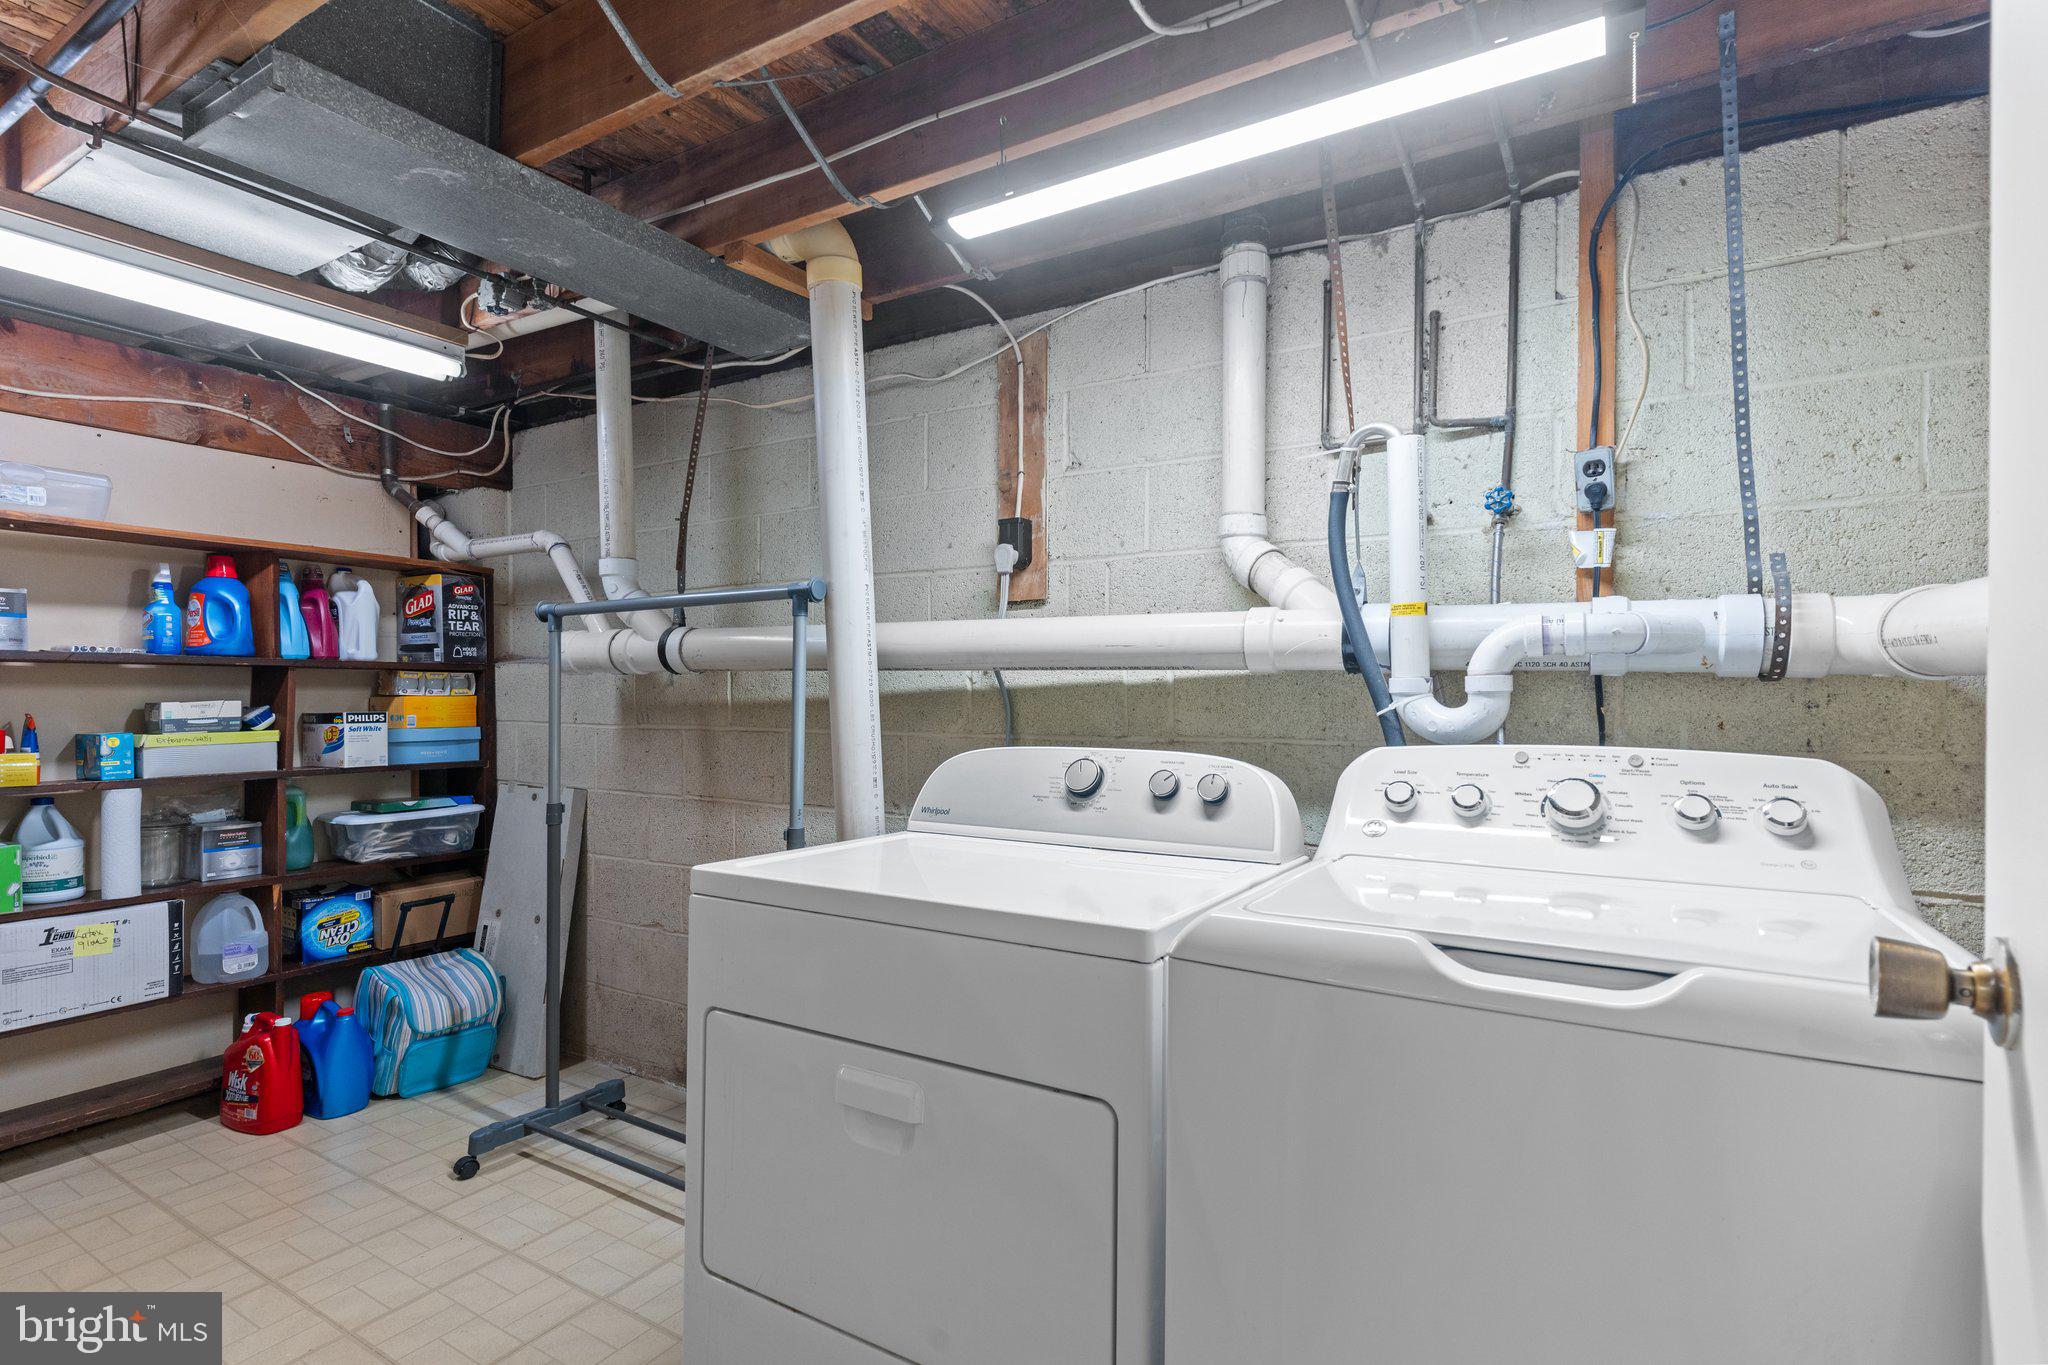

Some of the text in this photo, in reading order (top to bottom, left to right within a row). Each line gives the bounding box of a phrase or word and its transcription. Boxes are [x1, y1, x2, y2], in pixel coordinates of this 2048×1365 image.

[454, 586, 474, 595] GLAD
[405, 594, 433, 615] GLAD
[448, 609, 479, 621] RIP &
[448, 620, 480, 631] TEAR
[348, 714, 385, 722] PHILIPS
[348, 725, 362, 733] Soft
[921, 806, 952, 816] Whirlpool
[318, 919, 359, 941] CLEAN
[326, 931, 351, 948] OXI
[227, 1070, 248, 1090] Wisk
